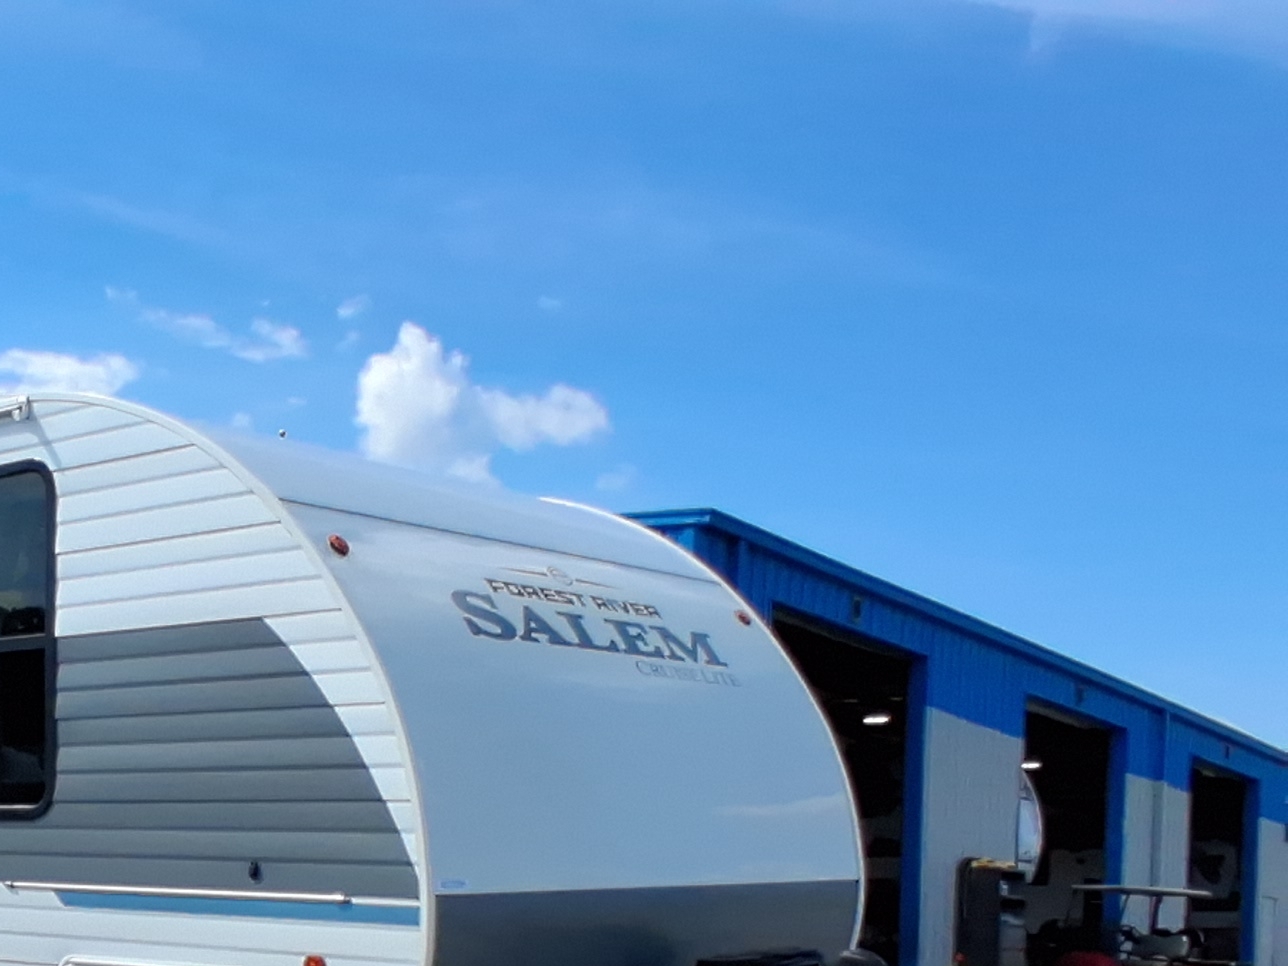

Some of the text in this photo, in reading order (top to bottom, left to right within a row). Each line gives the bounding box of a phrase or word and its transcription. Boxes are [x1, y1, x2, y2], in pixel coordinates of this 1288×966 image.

[450, 589, 728, 668] SALEM
[483, 578, 663, 620] FOREST RIVER
